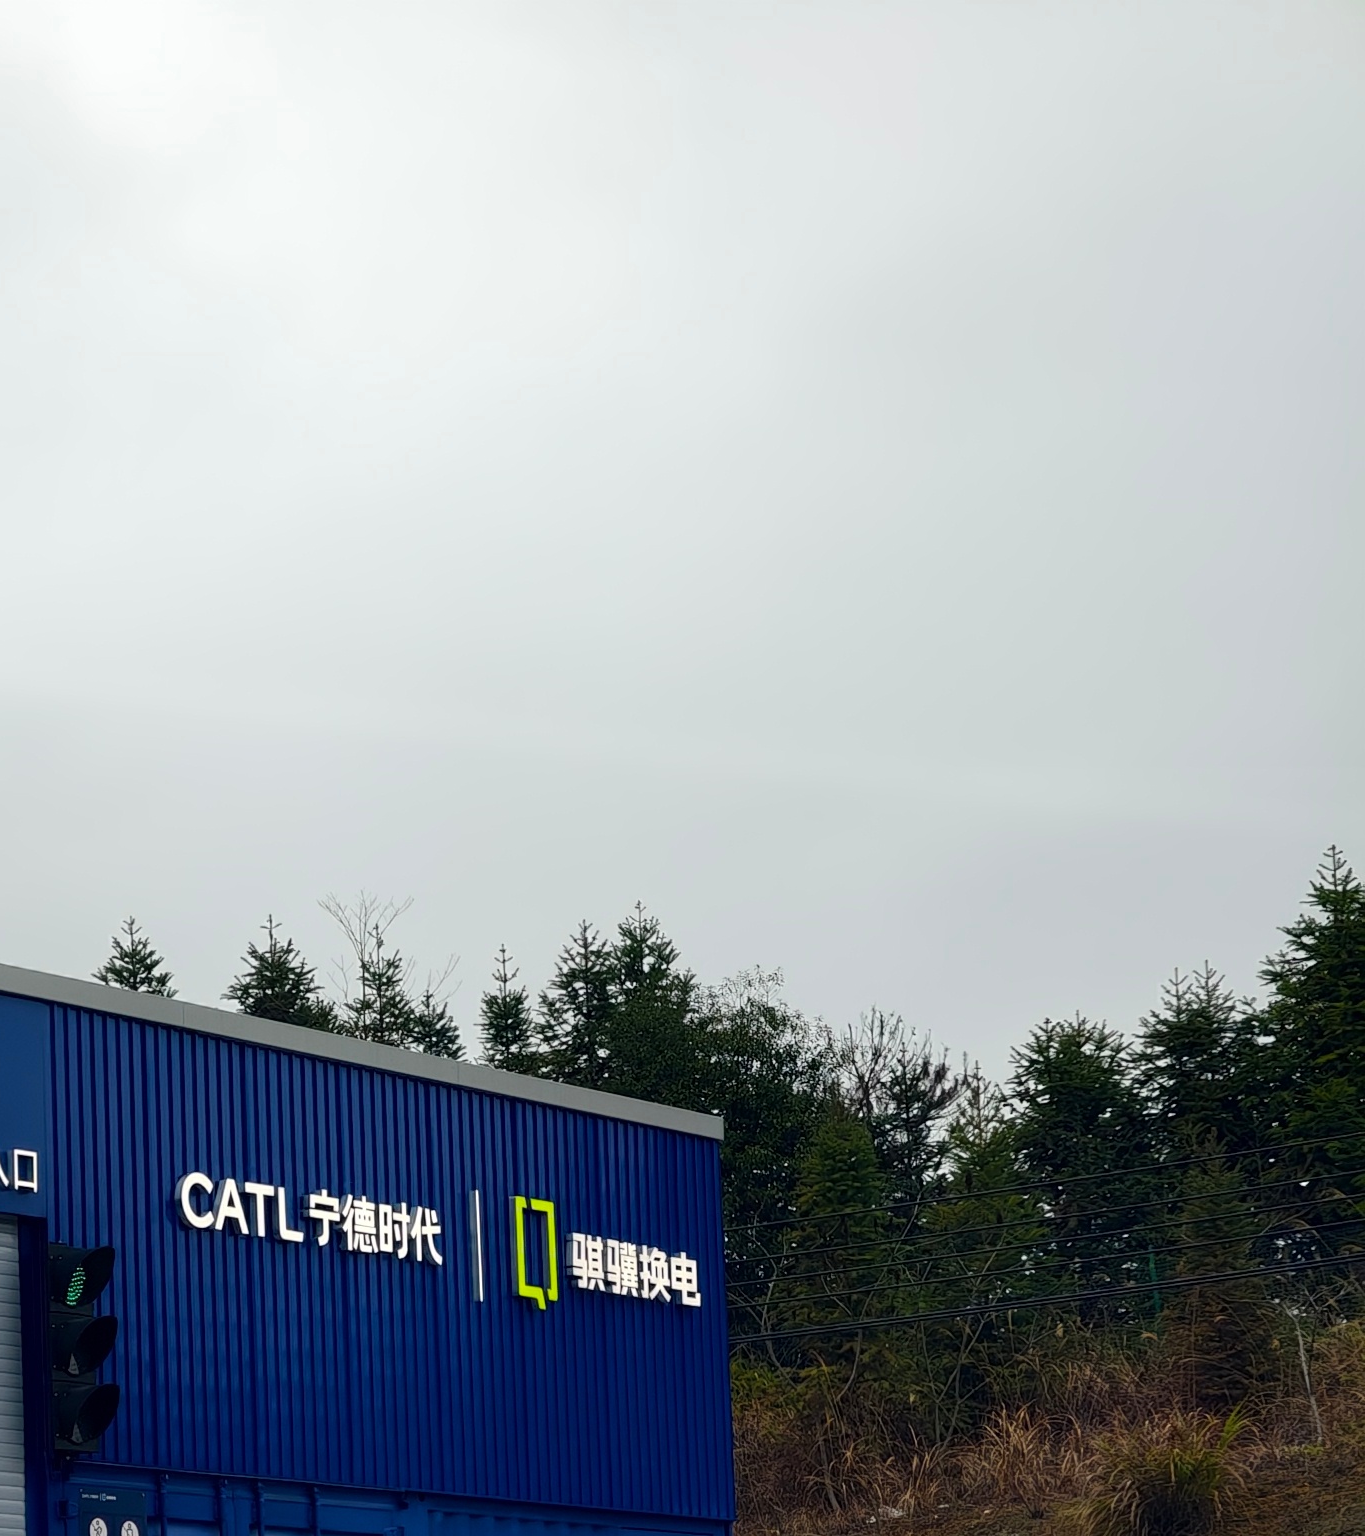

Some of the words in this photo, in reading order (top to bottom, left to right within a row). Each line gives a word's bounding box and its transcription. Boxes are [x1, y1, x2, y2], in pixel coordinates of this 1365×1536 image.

[179, 1171, 304, 1243] CATL
[308, 1188, 443, 1266] 宁德时代
[571, 1232, 702, 1307] 骐骥换电
